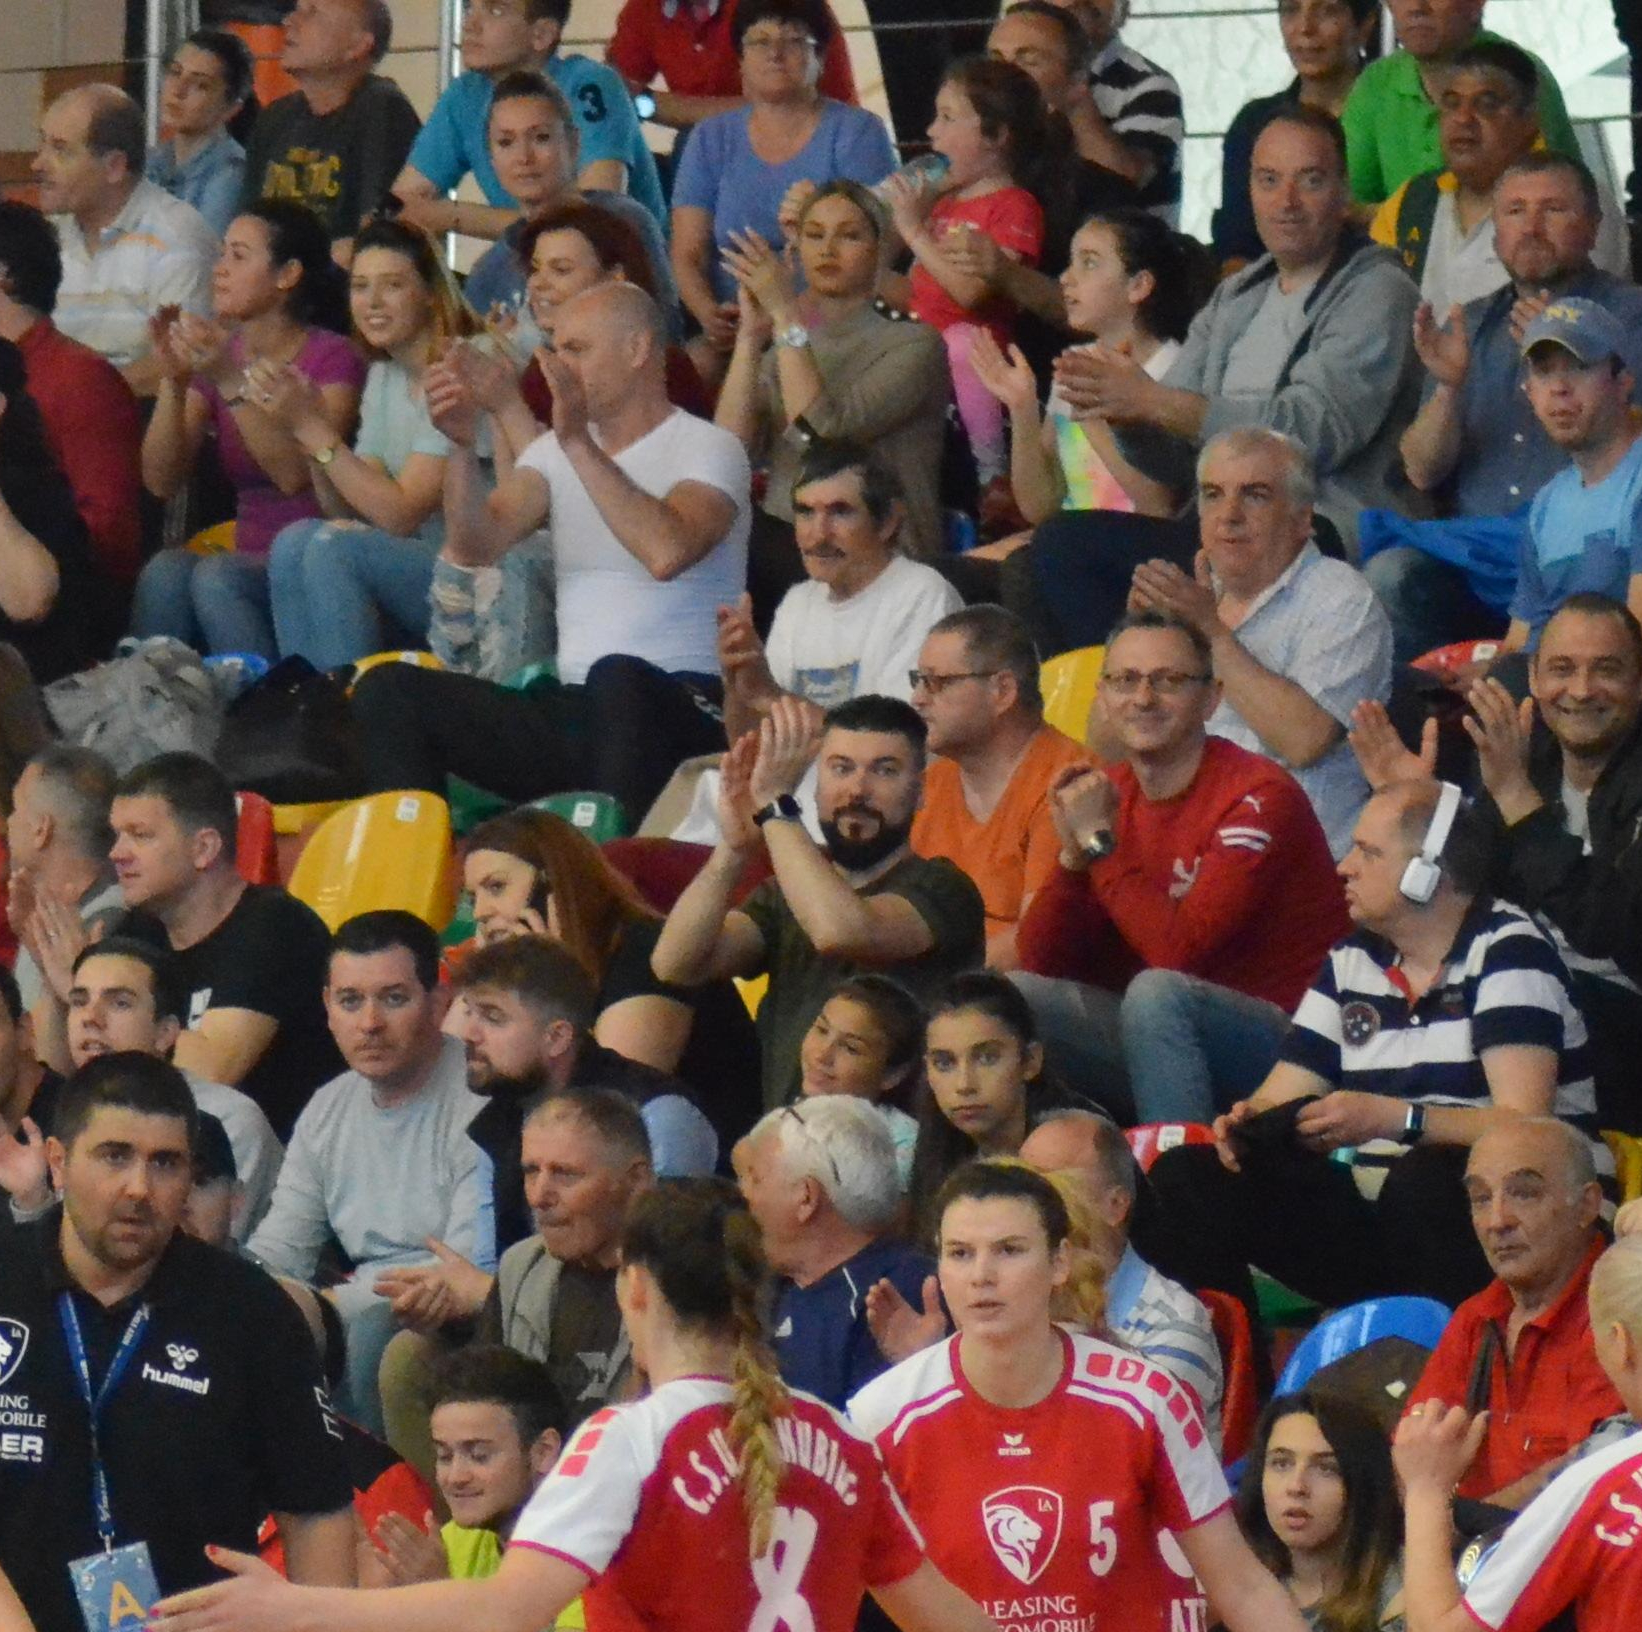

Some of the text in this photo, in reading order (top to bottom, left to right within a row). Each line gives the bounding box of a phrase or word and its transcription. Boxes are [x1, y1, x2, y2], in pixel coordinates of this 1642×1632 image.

[578, 84, 607, 122] 3
[141, 1362, 210, 1396] hummel
[1088, 1500, 1118, 1577] 5
[108, 1580, 148, 1628] A
[982, 1595, 1077, 1621] LEASING
